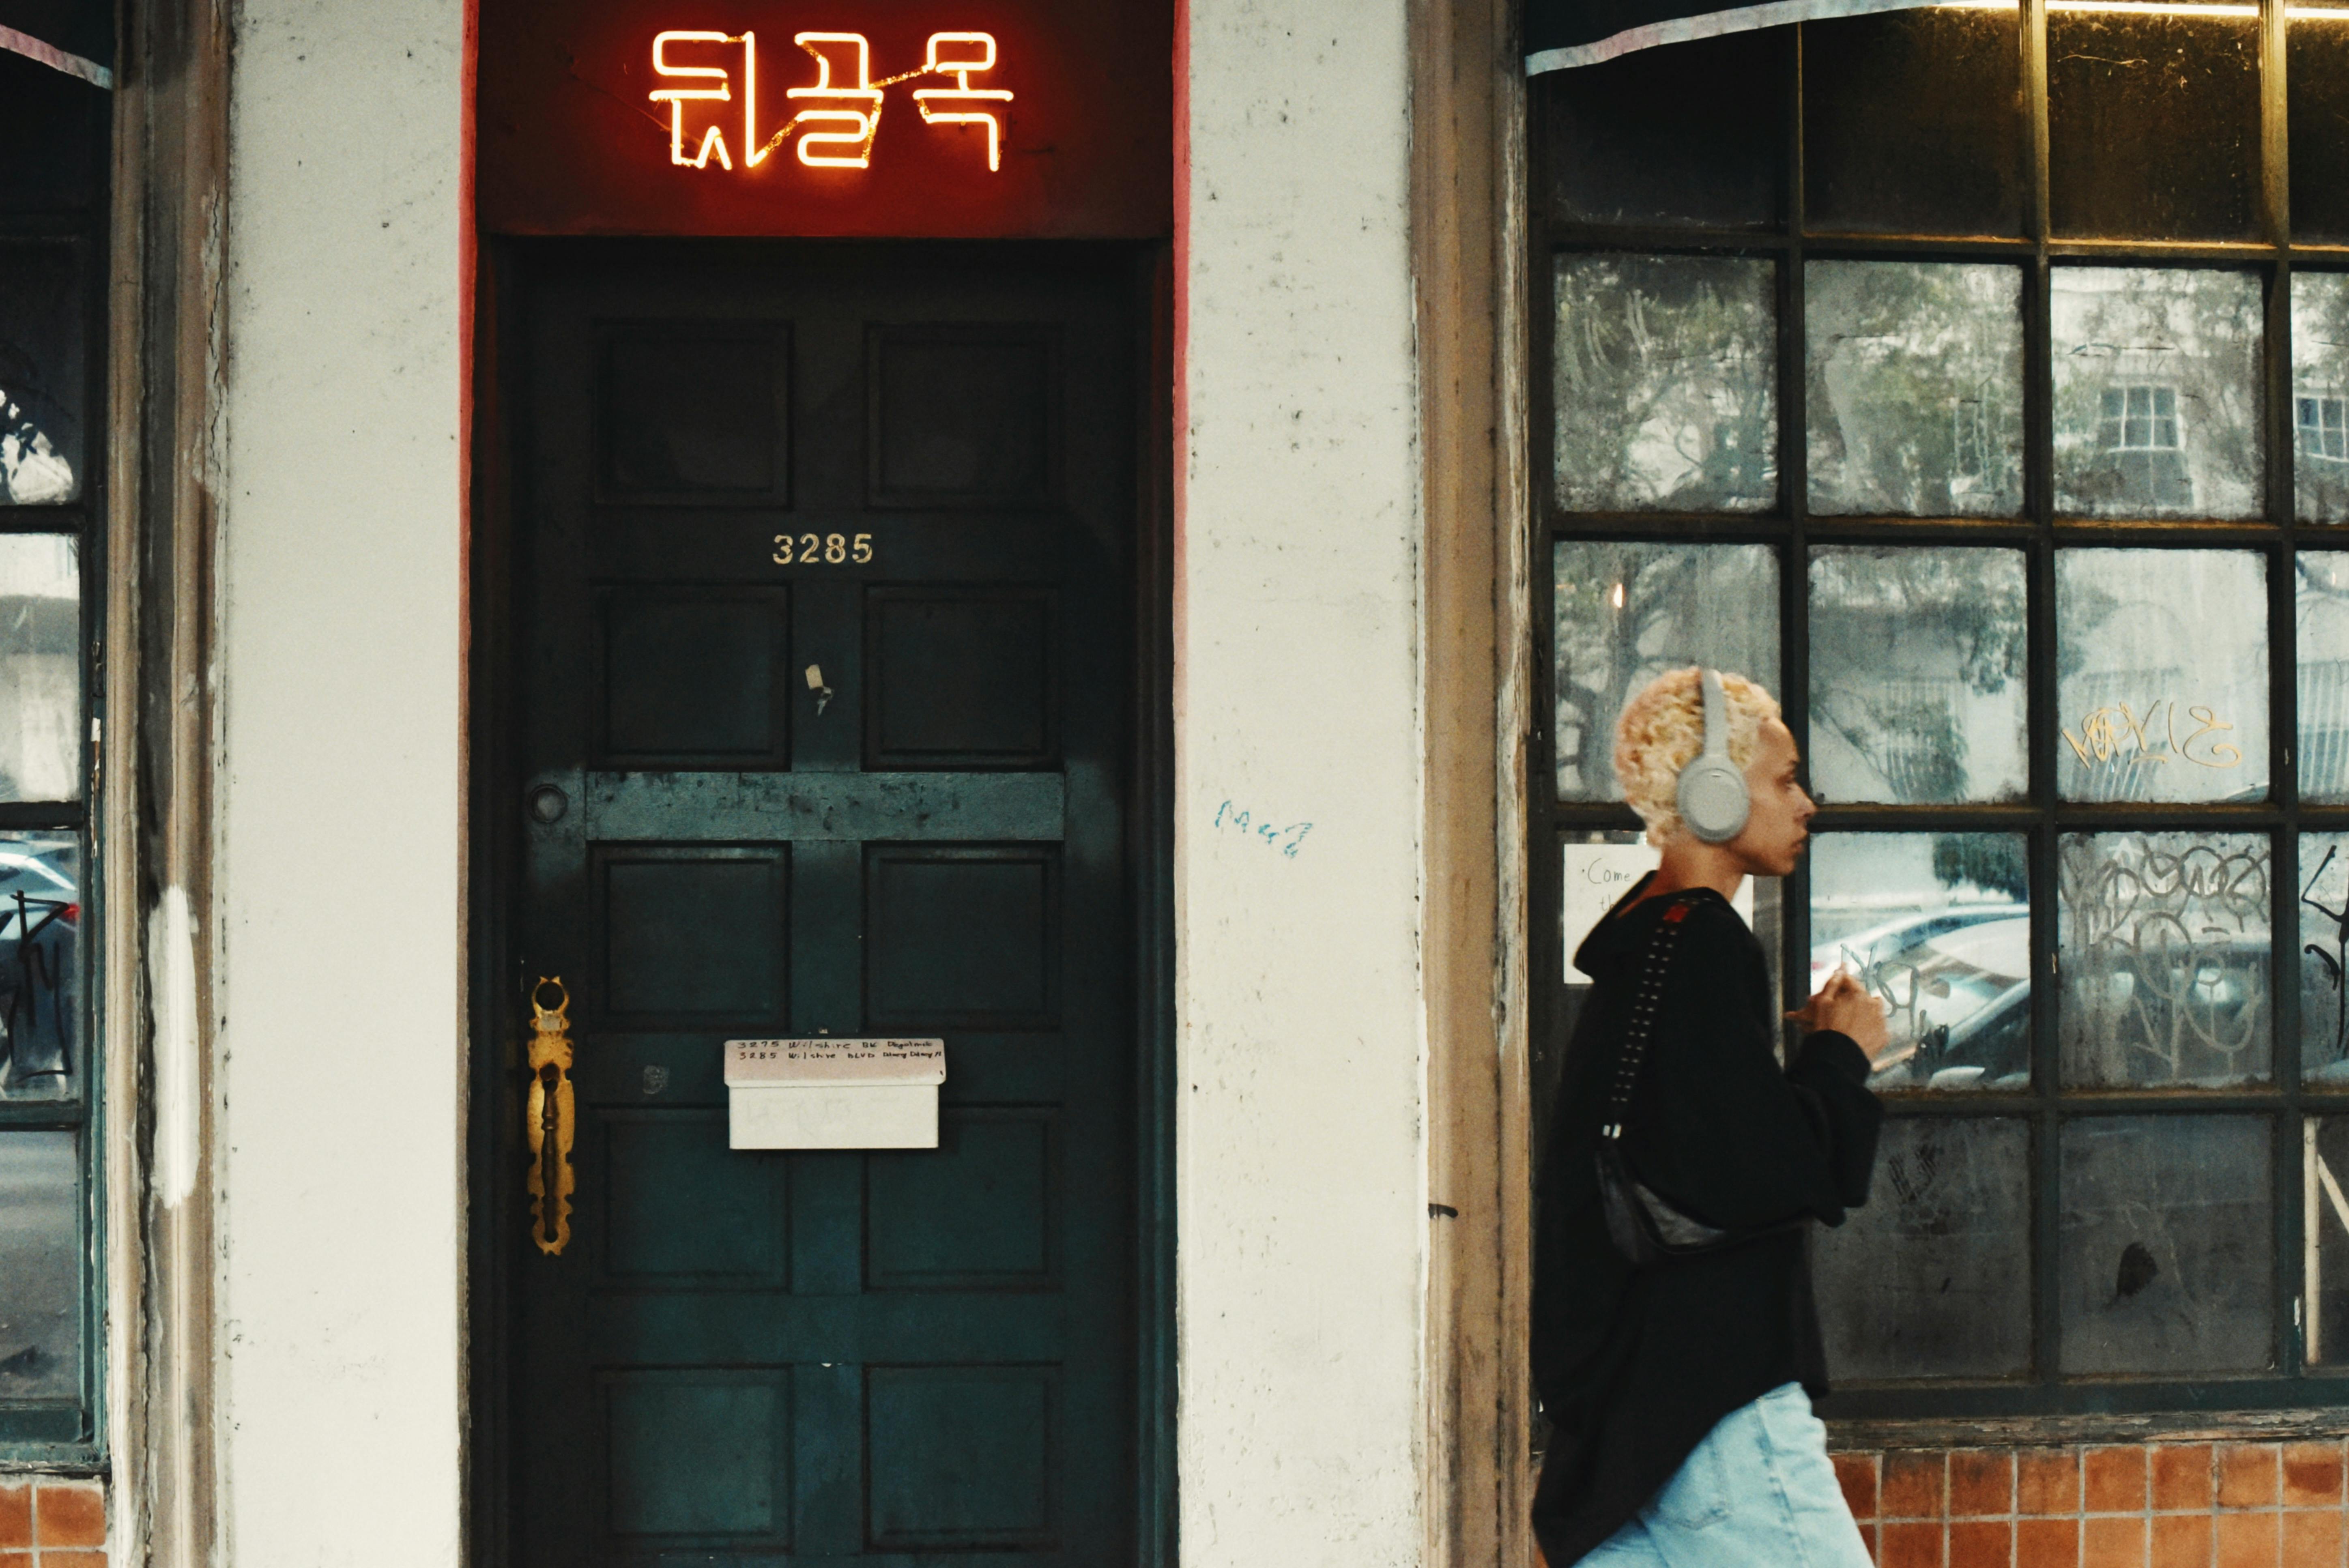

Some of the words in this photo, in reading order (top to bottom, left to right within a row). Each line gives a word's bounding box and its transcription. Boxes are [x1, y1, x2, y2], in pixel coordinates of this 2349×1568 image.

[649, 30, 1014, 172] 뒷골목
[773, 533, 873, 564] 3285
[1588, 858, 1630, 884] Come
